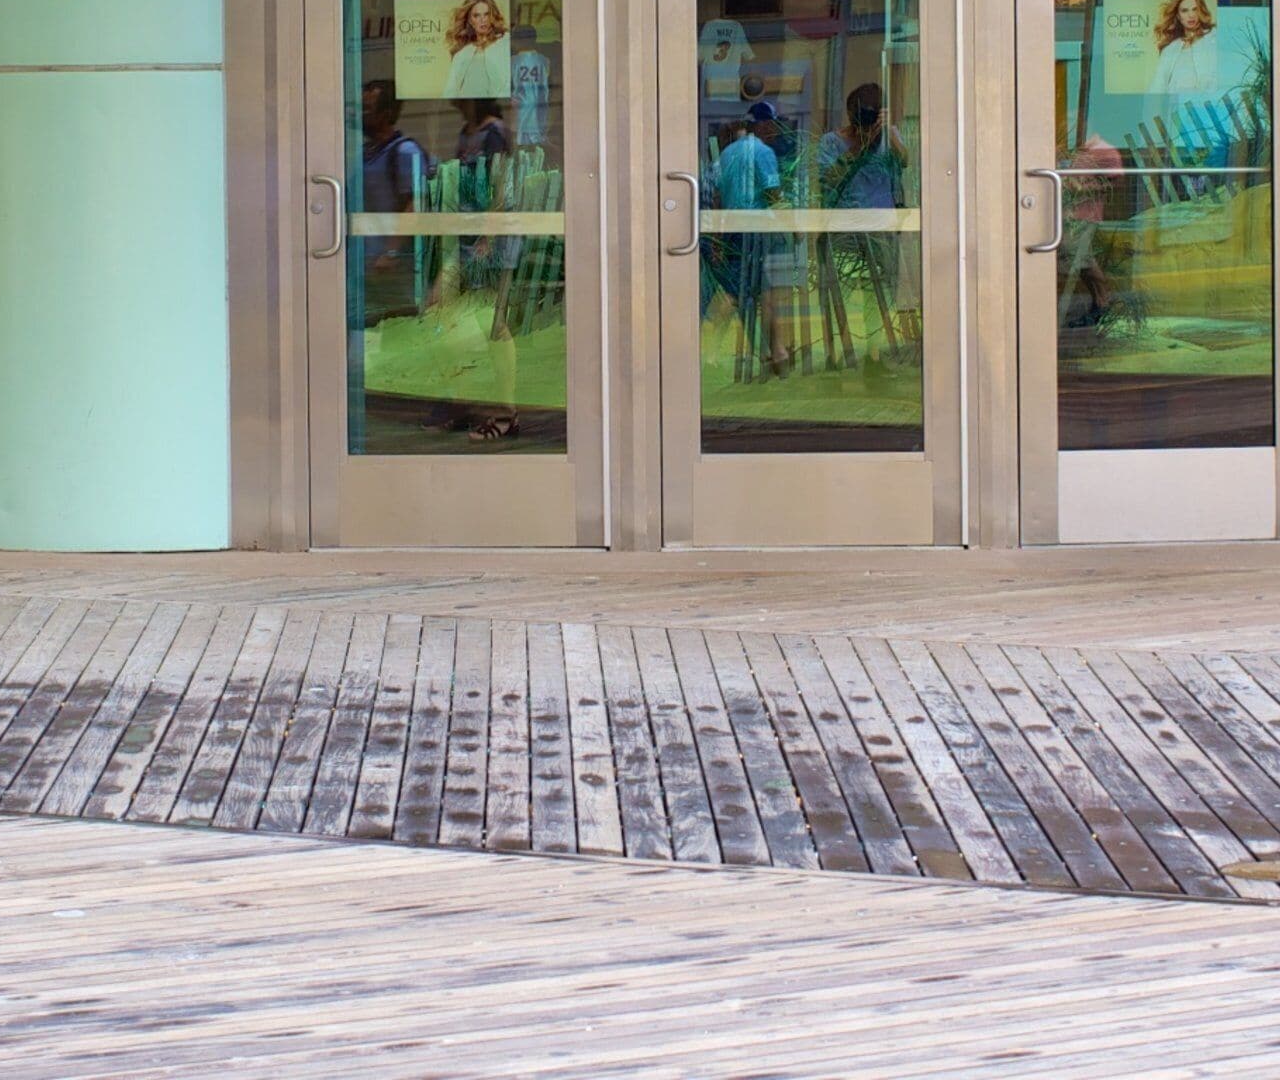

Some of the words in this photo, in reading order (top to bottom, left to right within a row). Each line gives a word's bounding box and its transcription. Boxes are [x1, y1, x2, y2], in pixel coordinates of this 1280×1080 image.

[399, 19, 441, 33] OPEN
[1107, 13, 1149, 28] OPEN
[520, 66, 538, 81] 24
